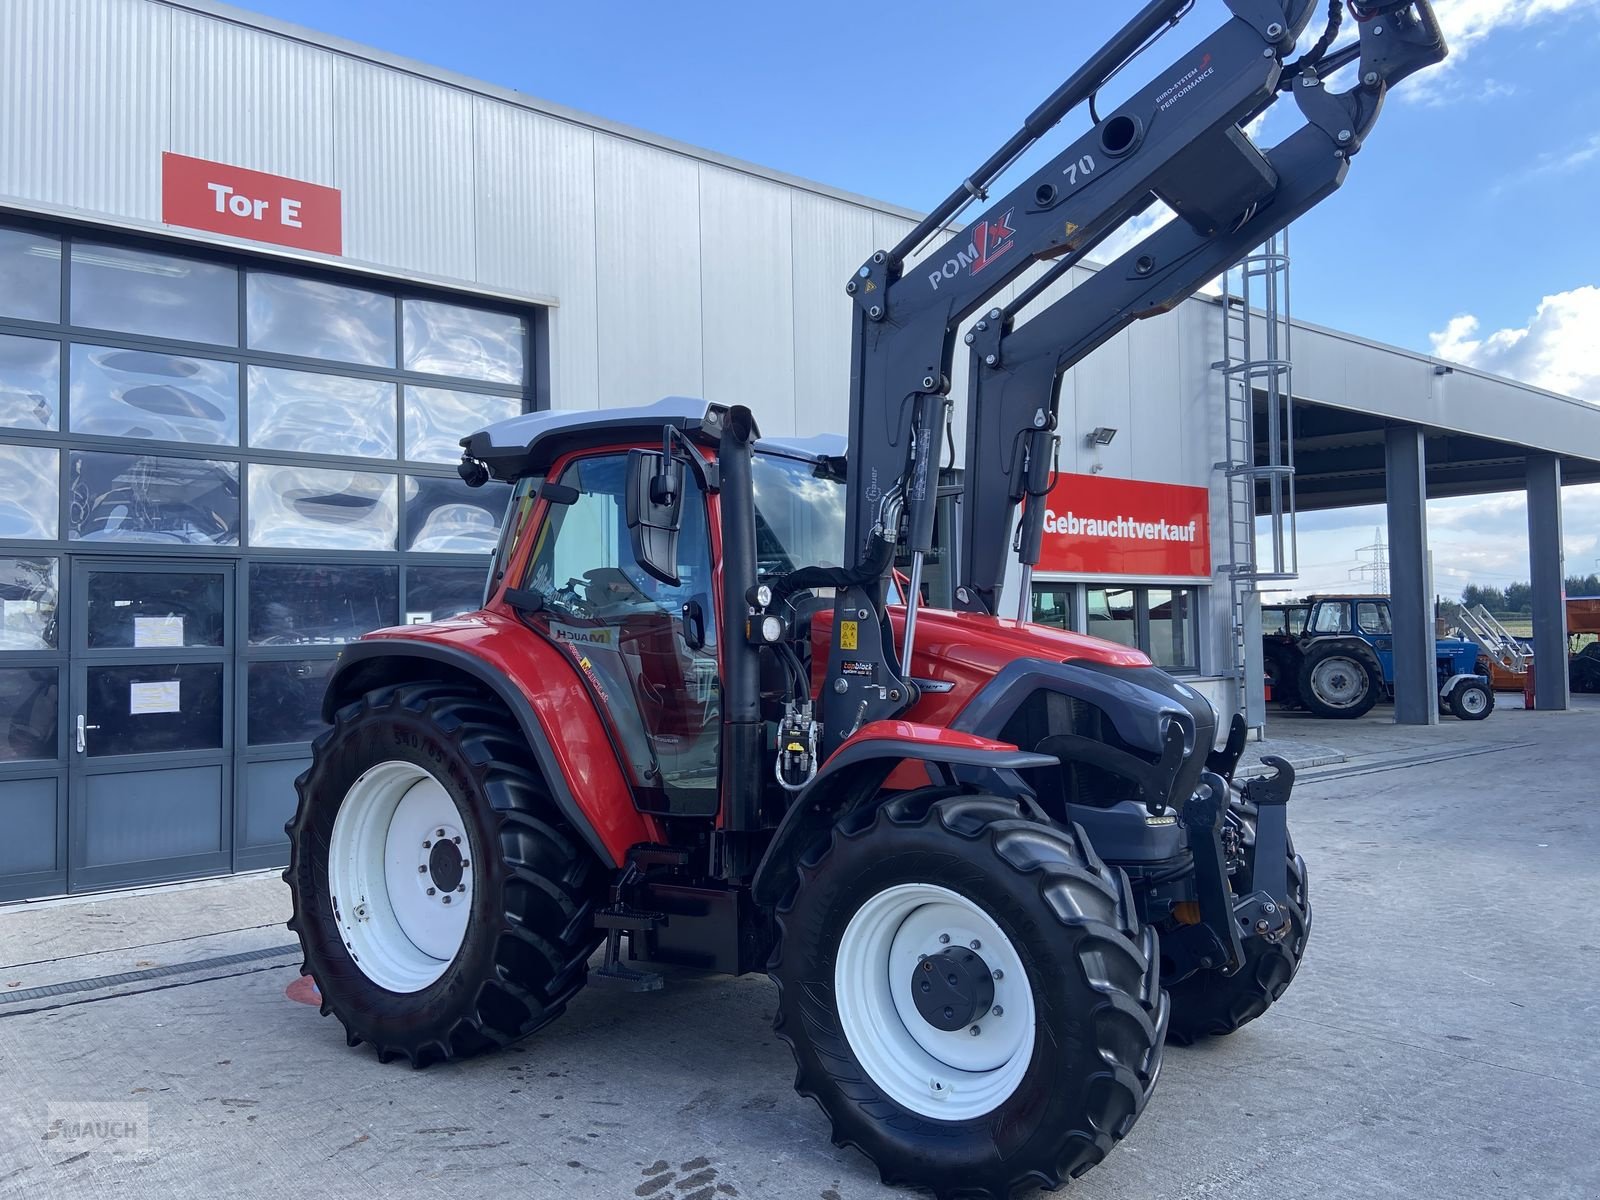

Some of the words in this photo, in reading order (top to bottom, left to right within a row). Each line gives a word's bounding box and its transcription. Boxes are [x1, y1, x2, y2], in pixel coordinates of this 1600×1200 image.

[1155, 68, 1198, 103] EURO-SYSTEM
[1160, 66, 1214, 112] PERFORMANCE
[1062, 154, 1096, 185] 70
[207, 182, 269, 220] Tor
[281, 197, 302, 228] E
[1043, 509, 1196, 542] Gebrauchtverkauf
